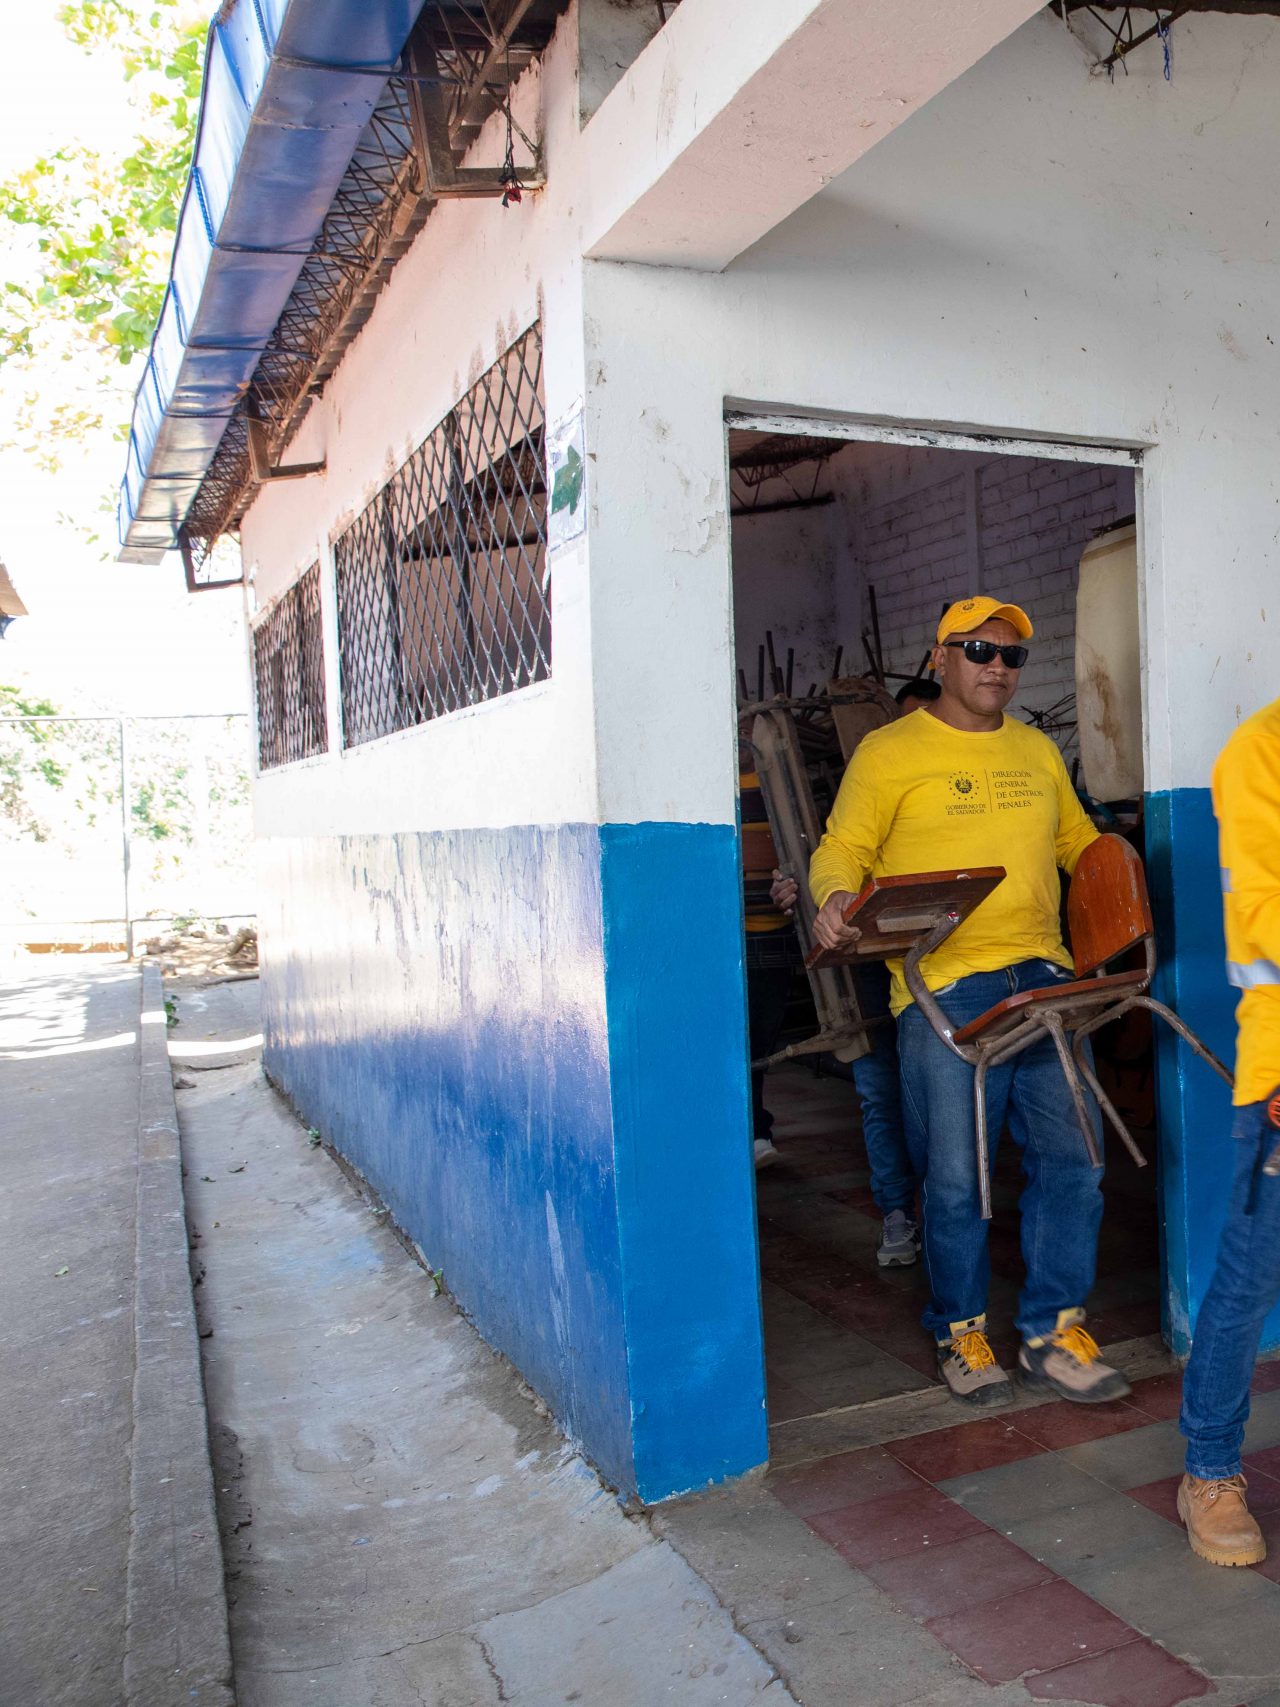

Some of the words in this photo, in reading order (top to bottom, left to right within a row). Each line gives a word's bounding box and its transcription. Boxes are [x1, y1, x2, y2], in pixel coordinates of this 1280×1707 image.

[994, 780, 1028, 788] GENERAL
[996, 791, 1008, 800] DE
[1009, 790, 1044, 798] CENTROS
[997, 800, 1032, 810] PENALES
